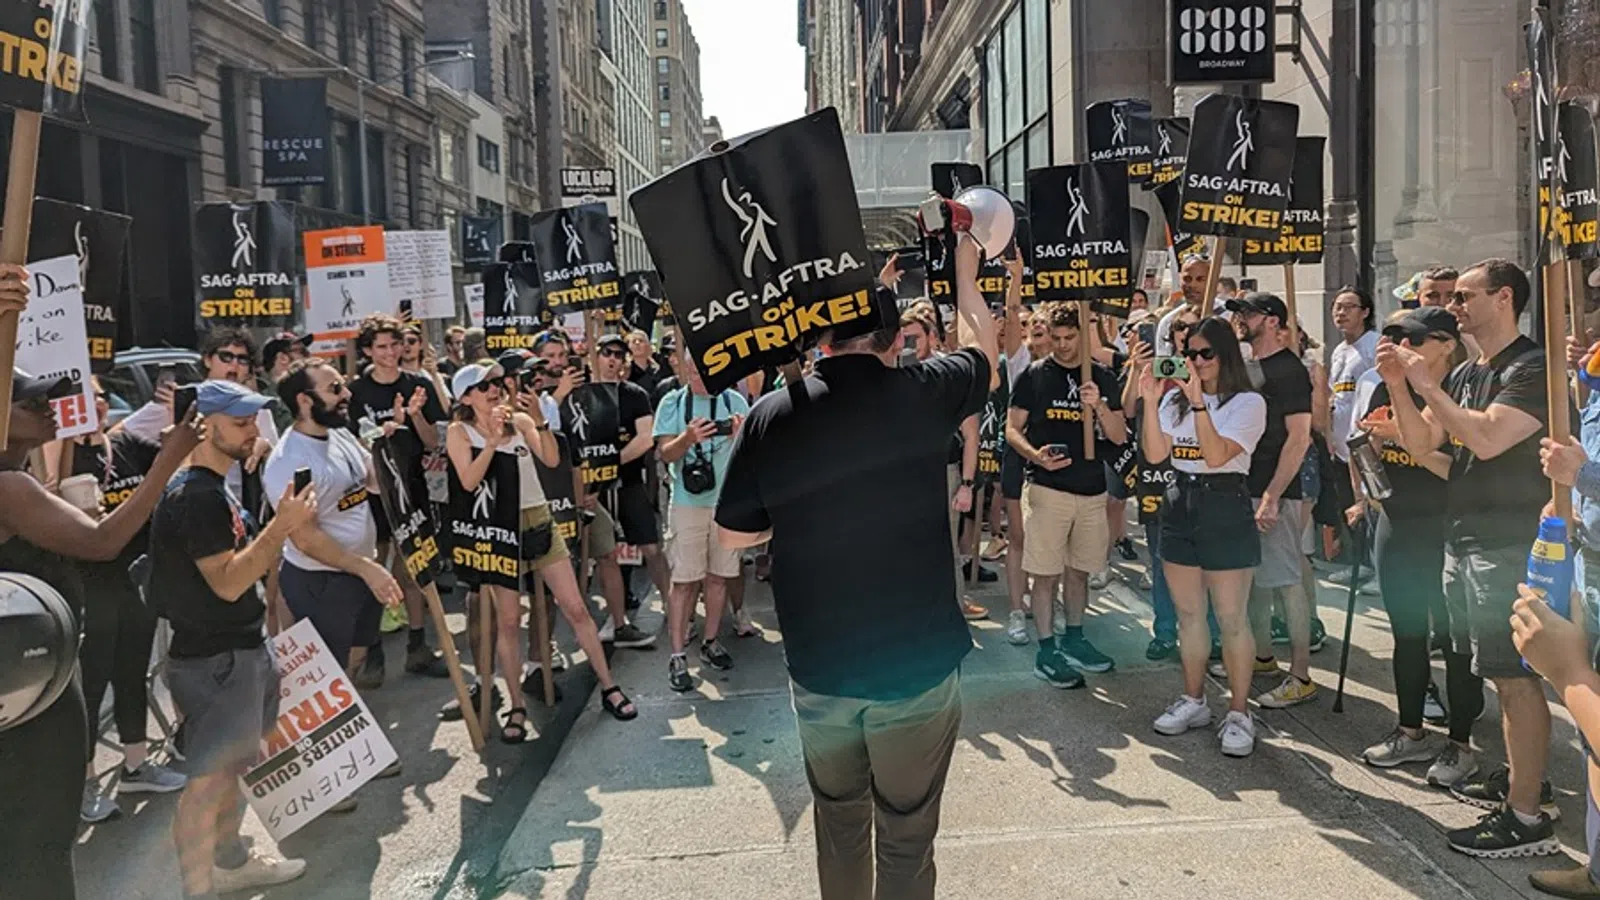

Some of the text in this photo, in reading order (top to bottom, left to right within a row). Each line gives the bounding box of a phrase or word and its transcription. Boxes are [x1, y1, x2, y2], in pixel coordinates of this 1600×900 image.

[1180, 6, 1265, 54] 888
[1199, 60, 1245, 68] BROADWAY
[264, 138, 323, 150] RESCUE
[278, 150, 307, 162] SPA
[562, 170, 591, 186] LOCAL
[1224, 194, 1244, 205] ON
[1183, 202, 1281, 229] STRIKE!
[1070, 259, 1088, 269] ON
[573, 278, 588, 287] ON
[1036, 267, 1129, 289] STRIKE!
[234, 288, 255, 298] ON
[547, 281, 619, 307] STRIKE!
[43, 307, 66, 319] on
[200, 298, 292, 317] STRIKE!
[762, 296, 795, 323] ON
[703, 289, 872, 376] STRIKE!
[474, 542, 492, 552] ON
[453, 547, 518, 578] STRIKE!
[296, 666, 328, 687] The
[258, 678, 353, 761] STRIK
[298, 737, 314, 755] ON
[253, 715, 370, 799] WRITERS GUILD
[268, 739, 377, 829] FRIENDS
